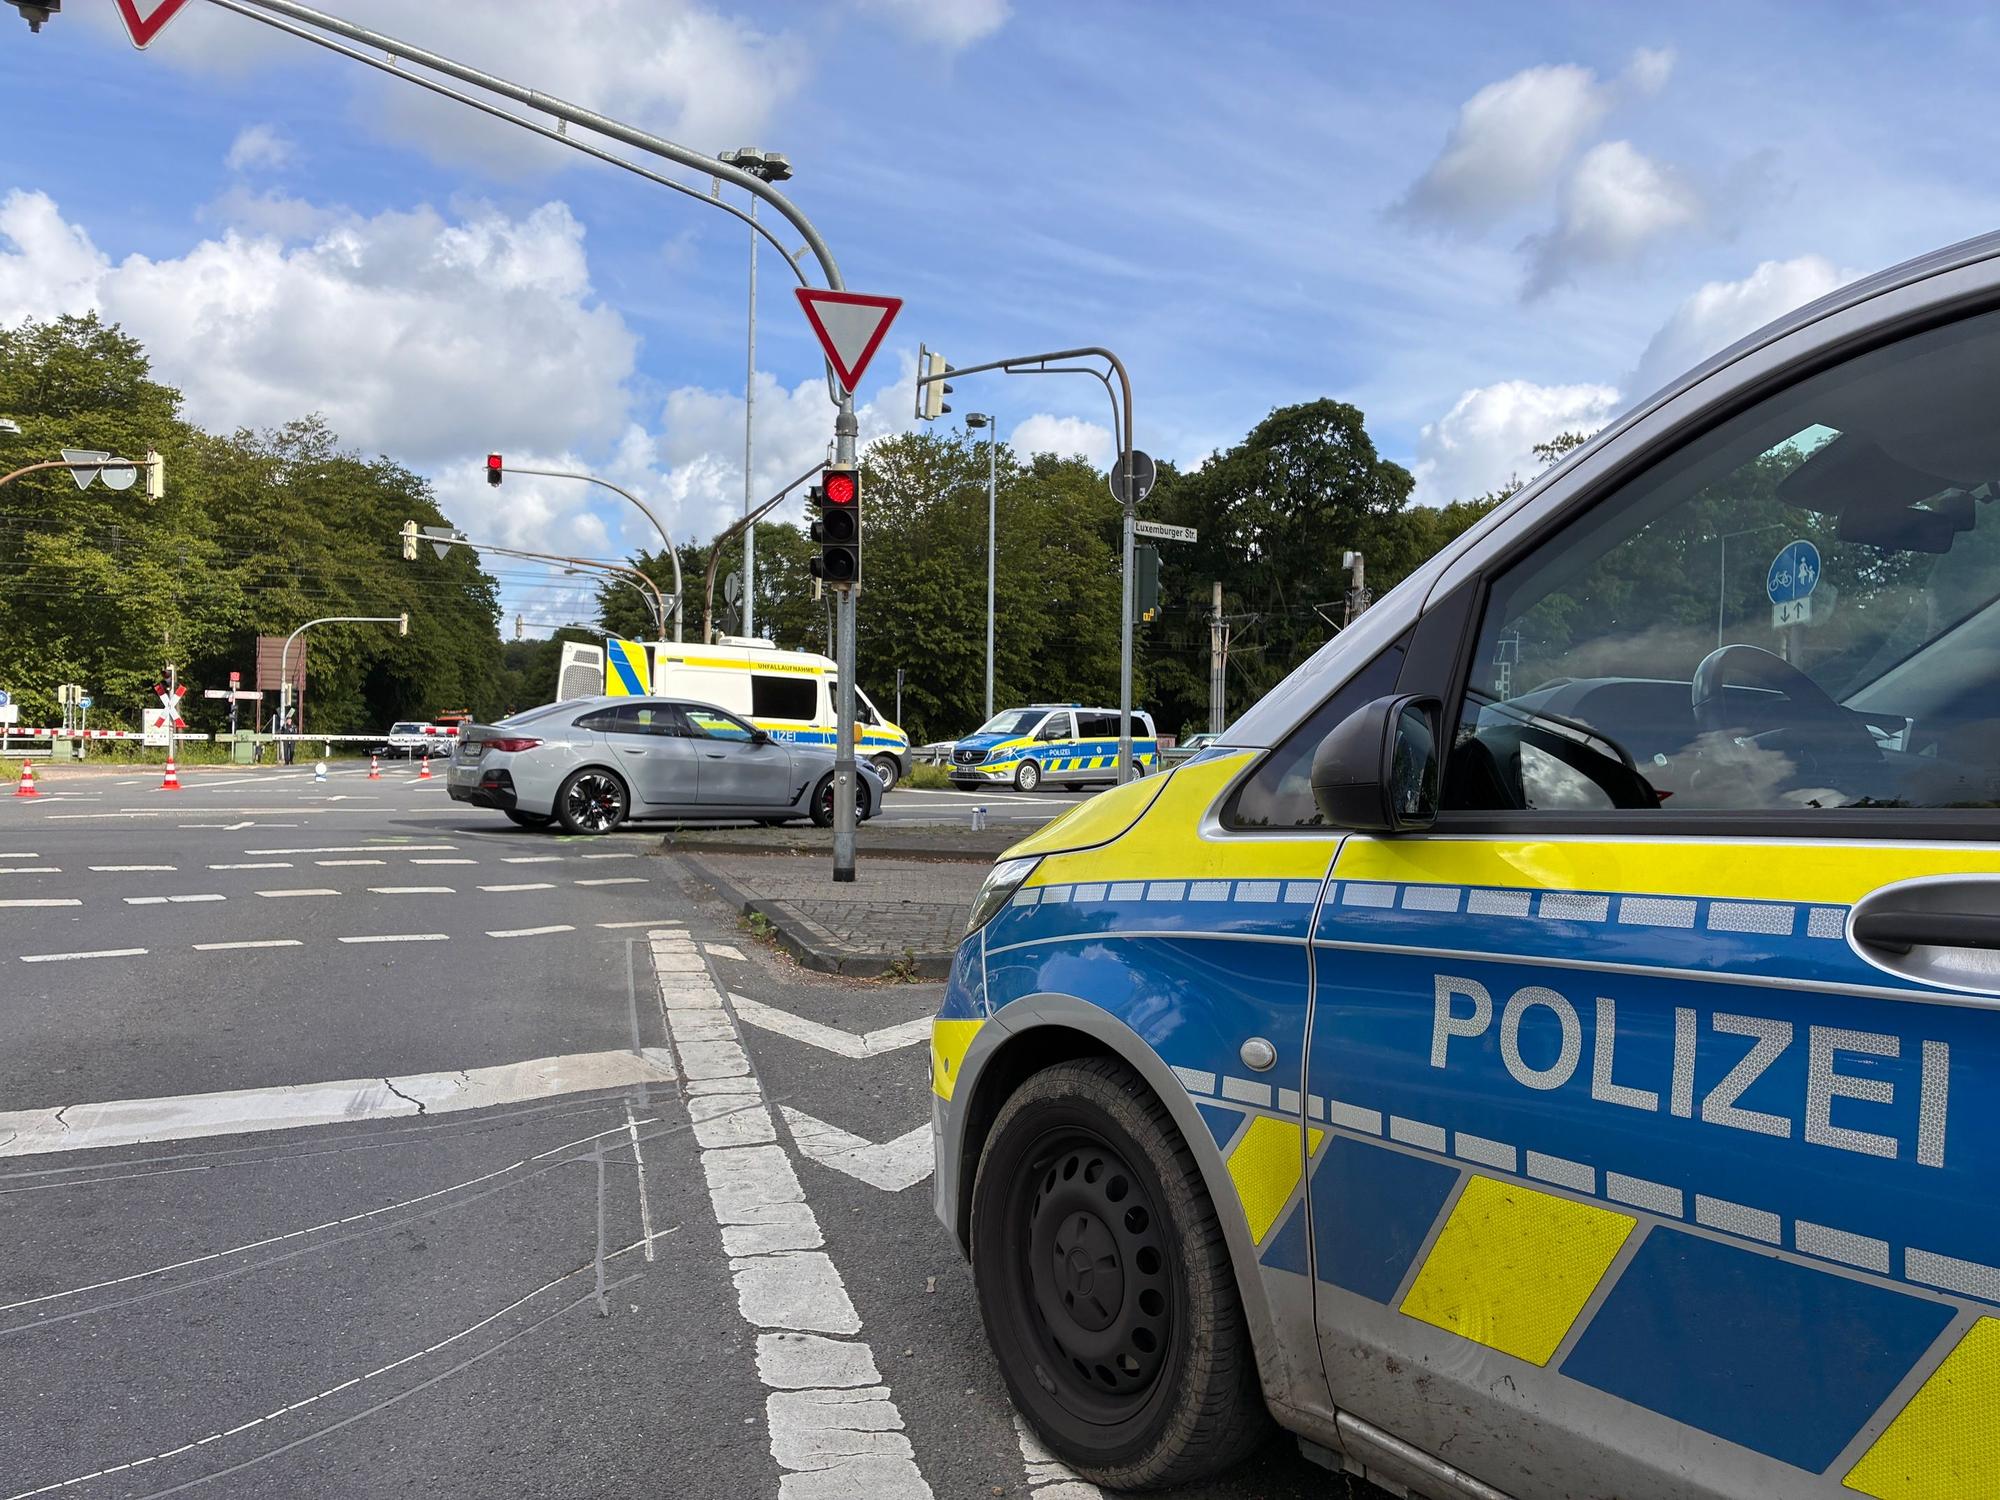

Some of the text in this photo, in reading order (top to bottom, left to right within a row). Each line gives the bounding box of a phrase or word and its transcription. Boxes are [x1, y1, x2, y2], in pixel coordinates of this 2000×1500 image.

[1135, 522, 1196, 539] Luxemburger Str.
[757, 663, 815, 674] UNFALLAUFNAHME
[1049, 748, 1071, 757] POLIZEI
[1430, 973, 1949, 1169] POLIZEI
